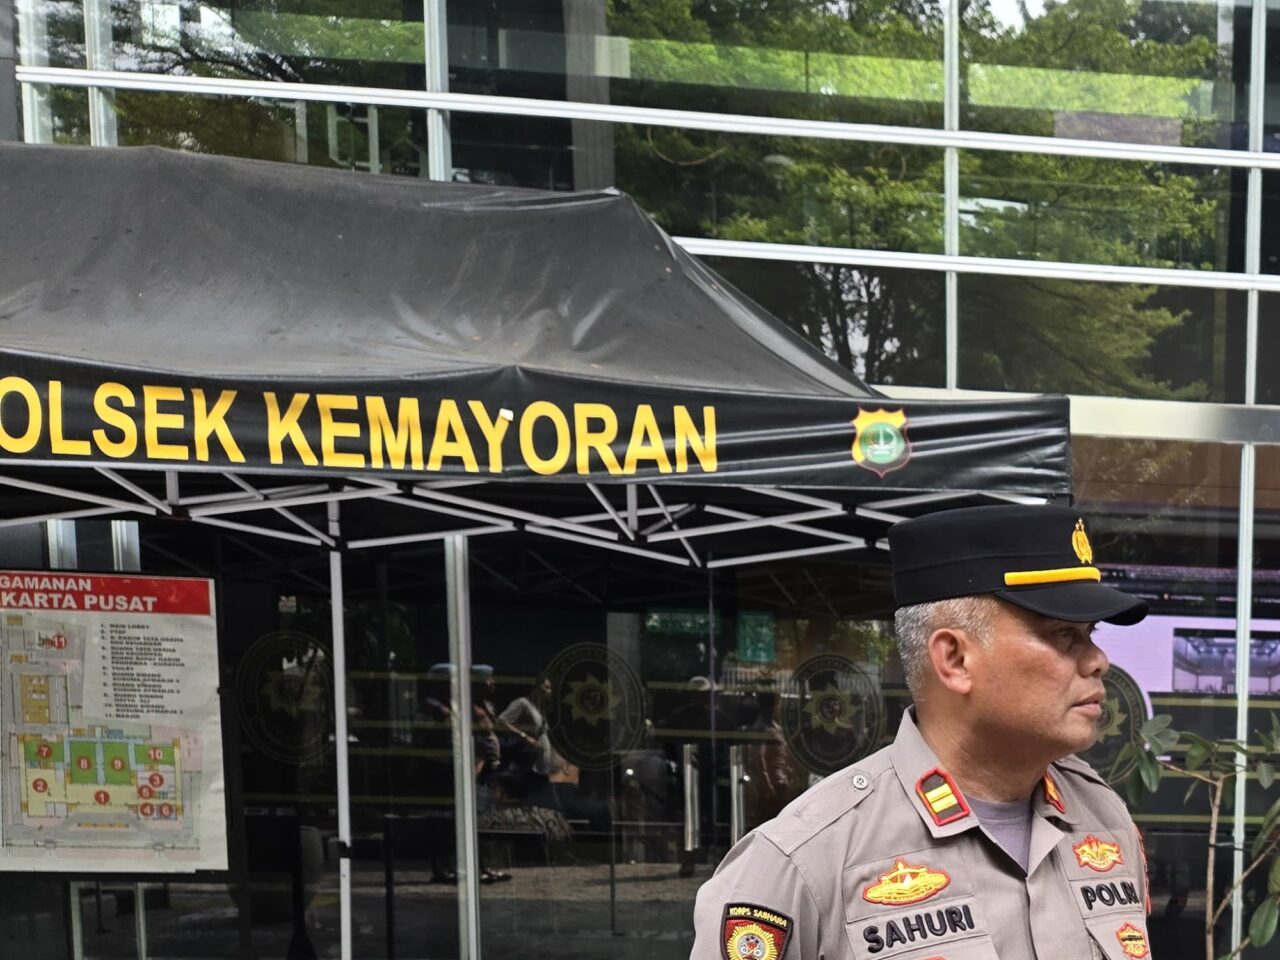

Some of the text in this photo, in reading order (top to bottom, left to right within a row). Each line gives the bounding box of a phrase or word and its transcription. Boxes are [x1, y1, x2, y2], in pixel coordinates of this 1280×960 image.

[0, 376, 718, 477] OLSEK KEMAYORAN
[84, 594, 158, 612] PUSAT
[53, 638, 65, 649] 11
[42, 748, 48, 757] 7
[149, 749, 163, 759] 10
[80, 758, 87, 768] 8
[114, 759, 121, 769] 9
[36, 780, 44, 790] 2
[154, 775, 161, 785] 3
[100, 793, 105, 802] 1
[143, 805, 151, 815] 4
[729, 907, 787, 927] KORPS SABHARA
[863, 904, 975, 953] SAHURI
